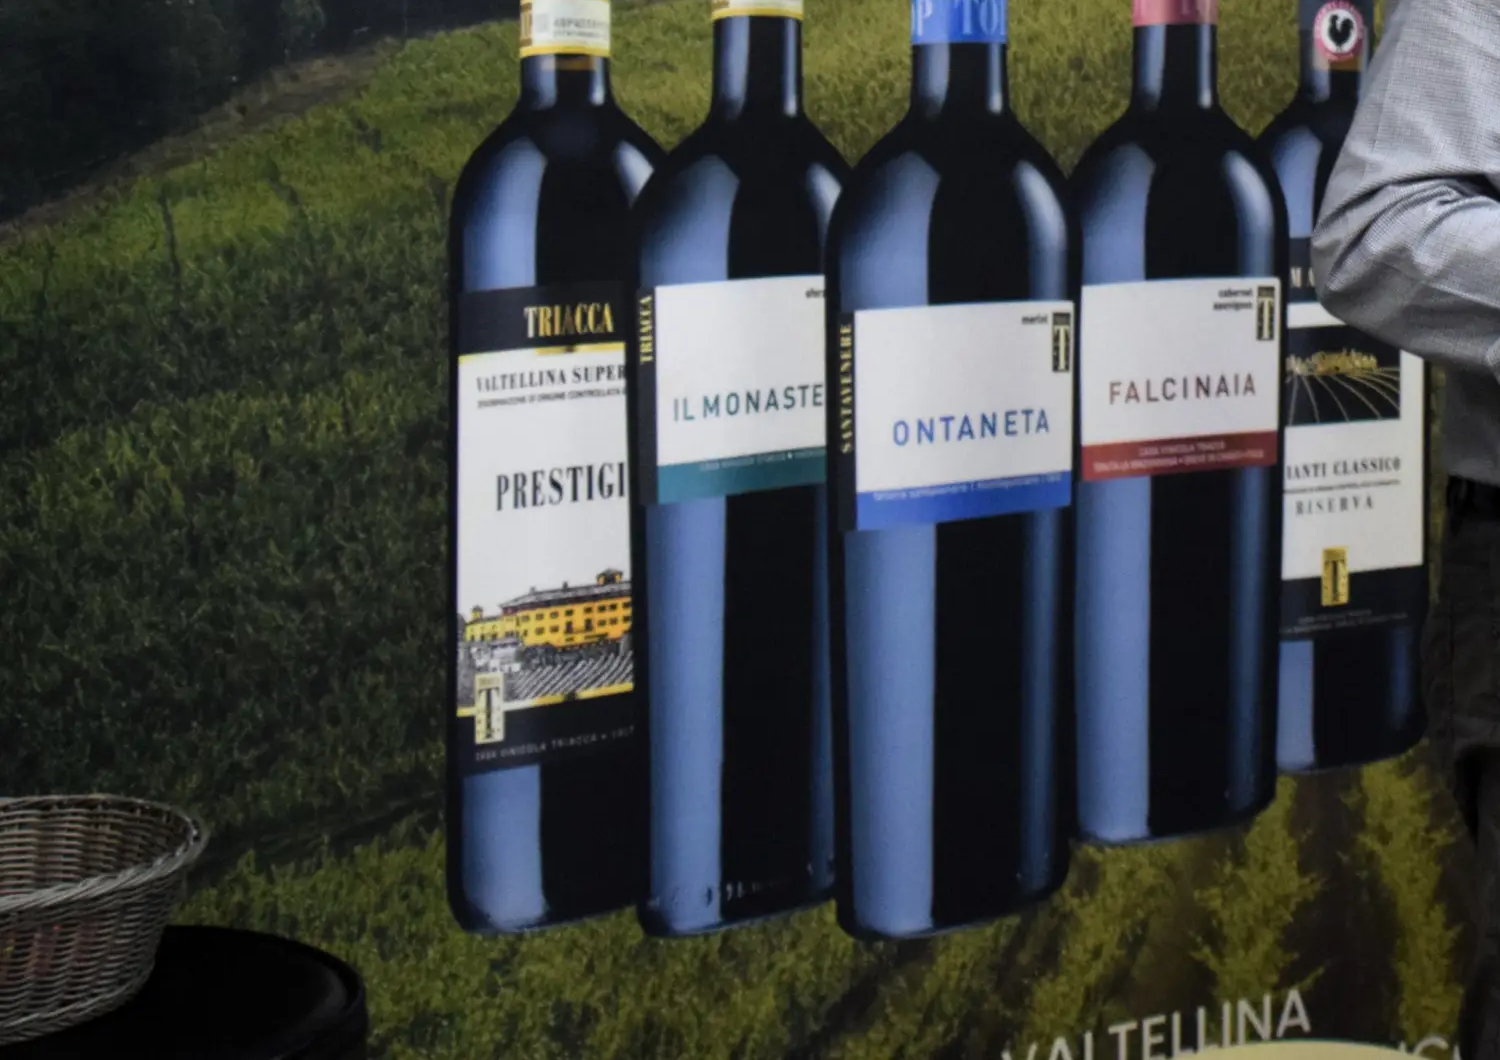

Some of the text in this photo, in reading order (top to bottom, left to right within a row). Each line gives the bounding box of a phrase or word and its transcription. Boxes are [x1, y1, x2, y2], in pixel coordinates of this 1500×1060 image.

[523, 303, 615, 338] TRIACCA
[640, 295, 653, 364] TRIACCA
[476, 369, 566, 392] VALTELLINA
[1108, 372, 1256, 405] FALCINAIA
[673, 384, 825, 422] IL MONASTE
[892, 408, 1050, 446] ONTANETA
[1332, 456, 1402, 476] CLASSICO
[495, 461, 626, 512] PRESTIGI
[1295, 493, 1374, 516] RISERVA
